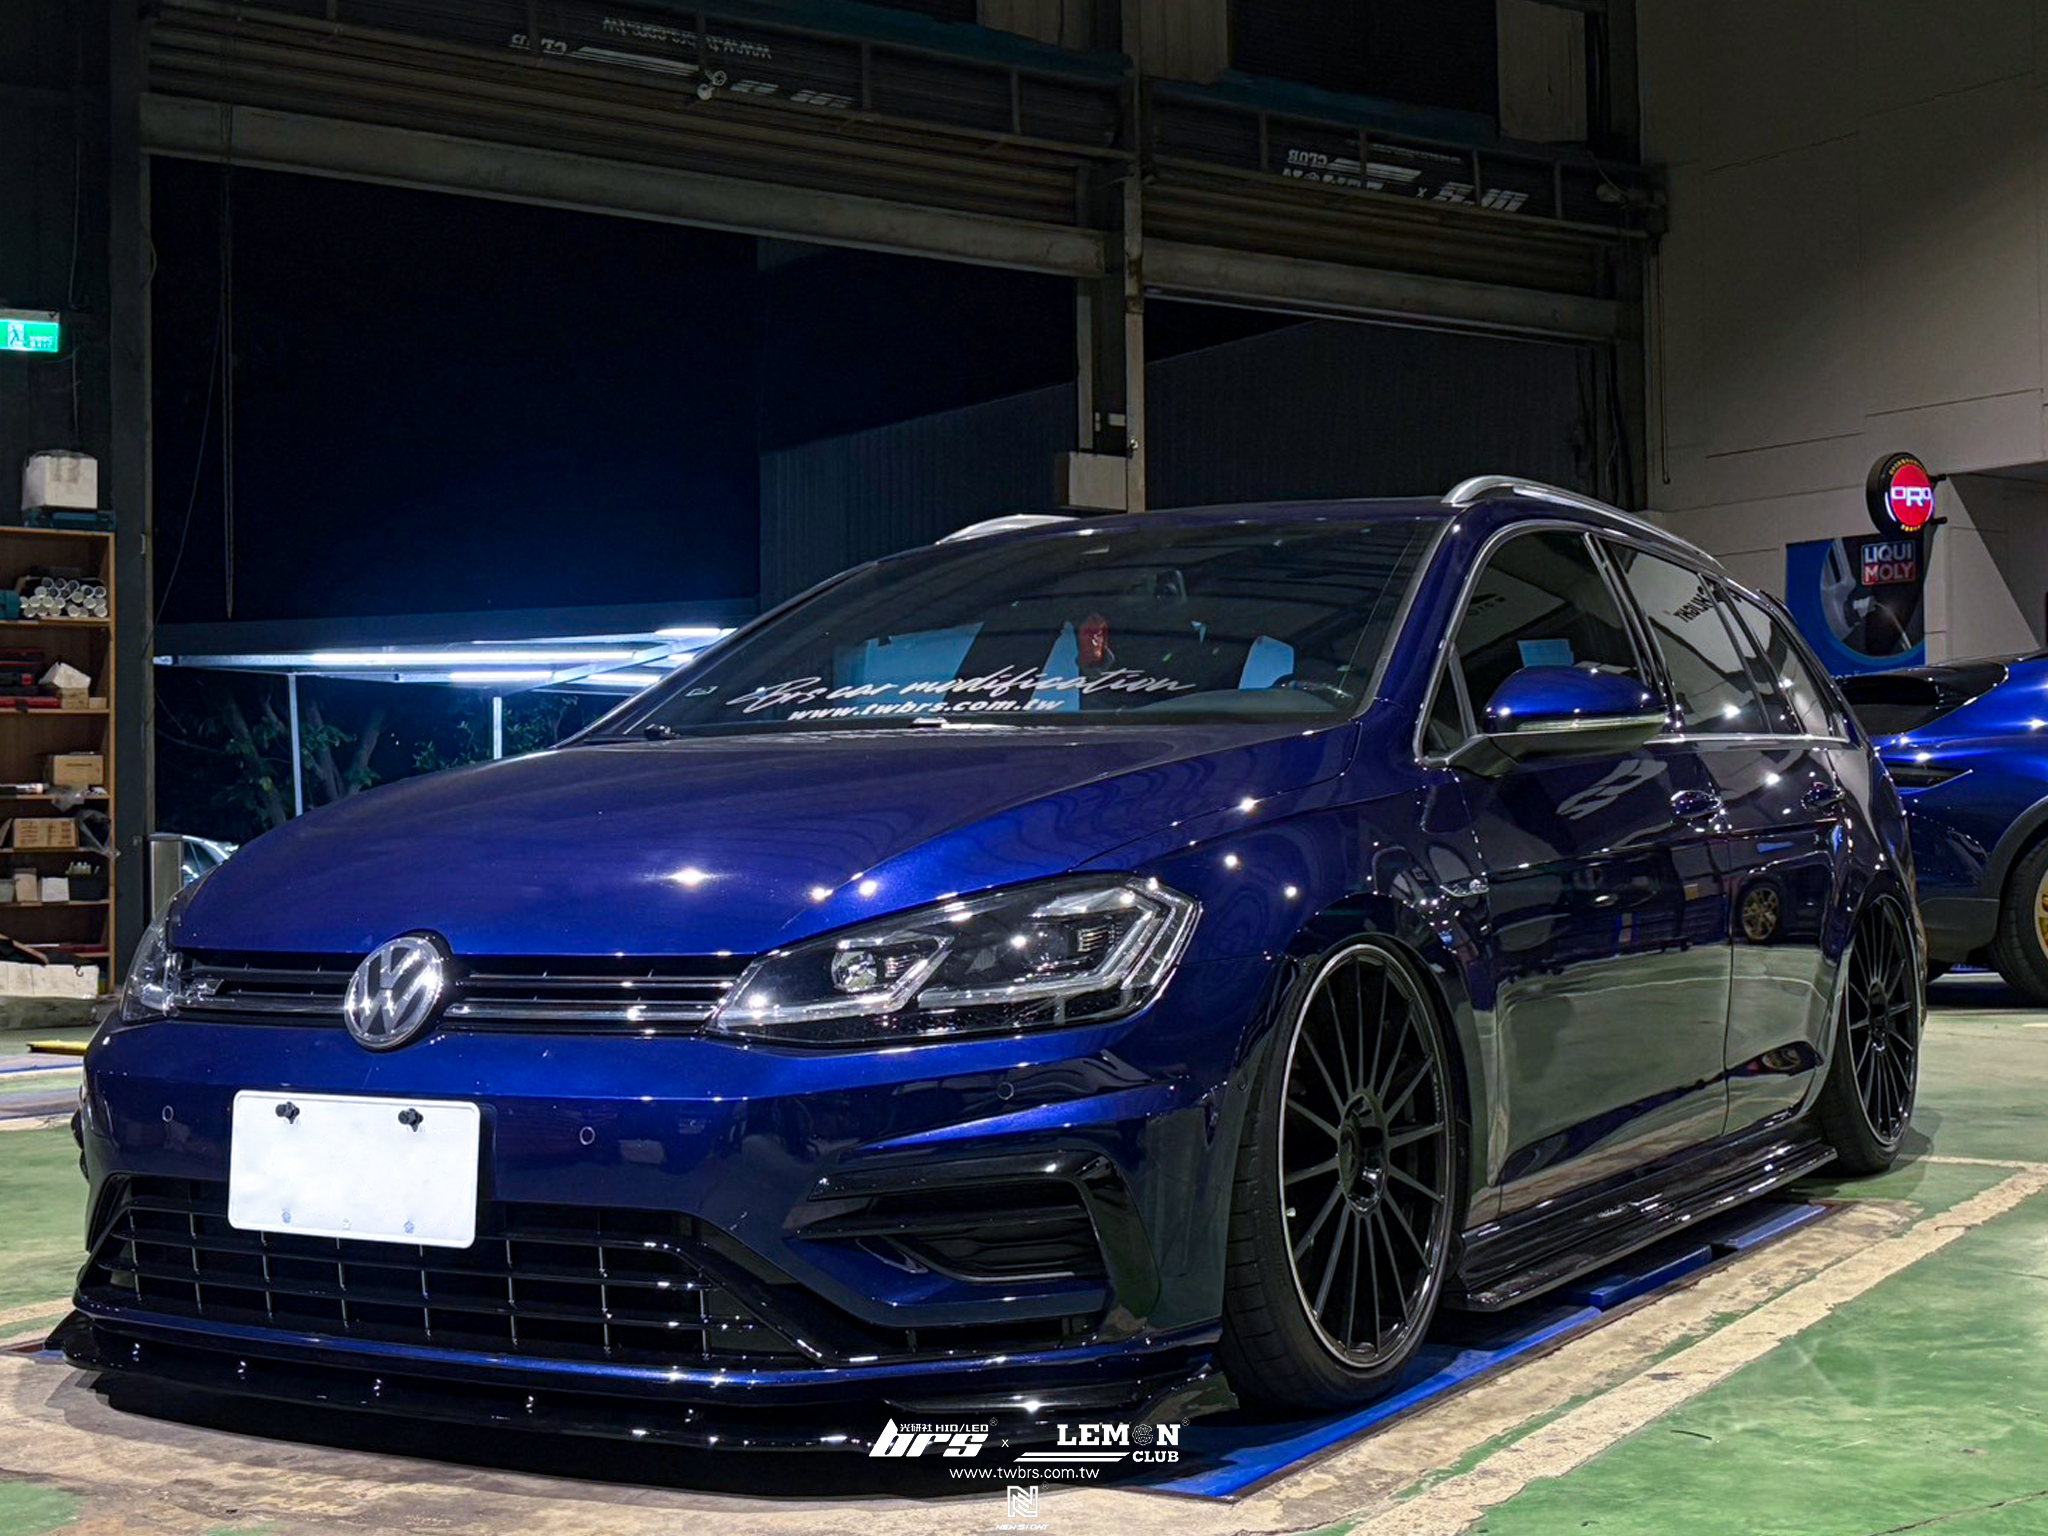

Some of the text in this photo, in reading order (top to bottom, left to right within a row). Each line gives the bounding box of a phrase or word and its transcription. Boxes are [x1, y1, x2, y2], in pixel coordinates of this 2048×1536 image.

[1864, 543, 1912, 563] LIQUI
[1864, 562, 1913, 582] MOLY
[826, 685, 898, 699] car
[899, 665, 1196, 698] modification
[787, 699, 1064, 721] www.twbrs.com.tw
